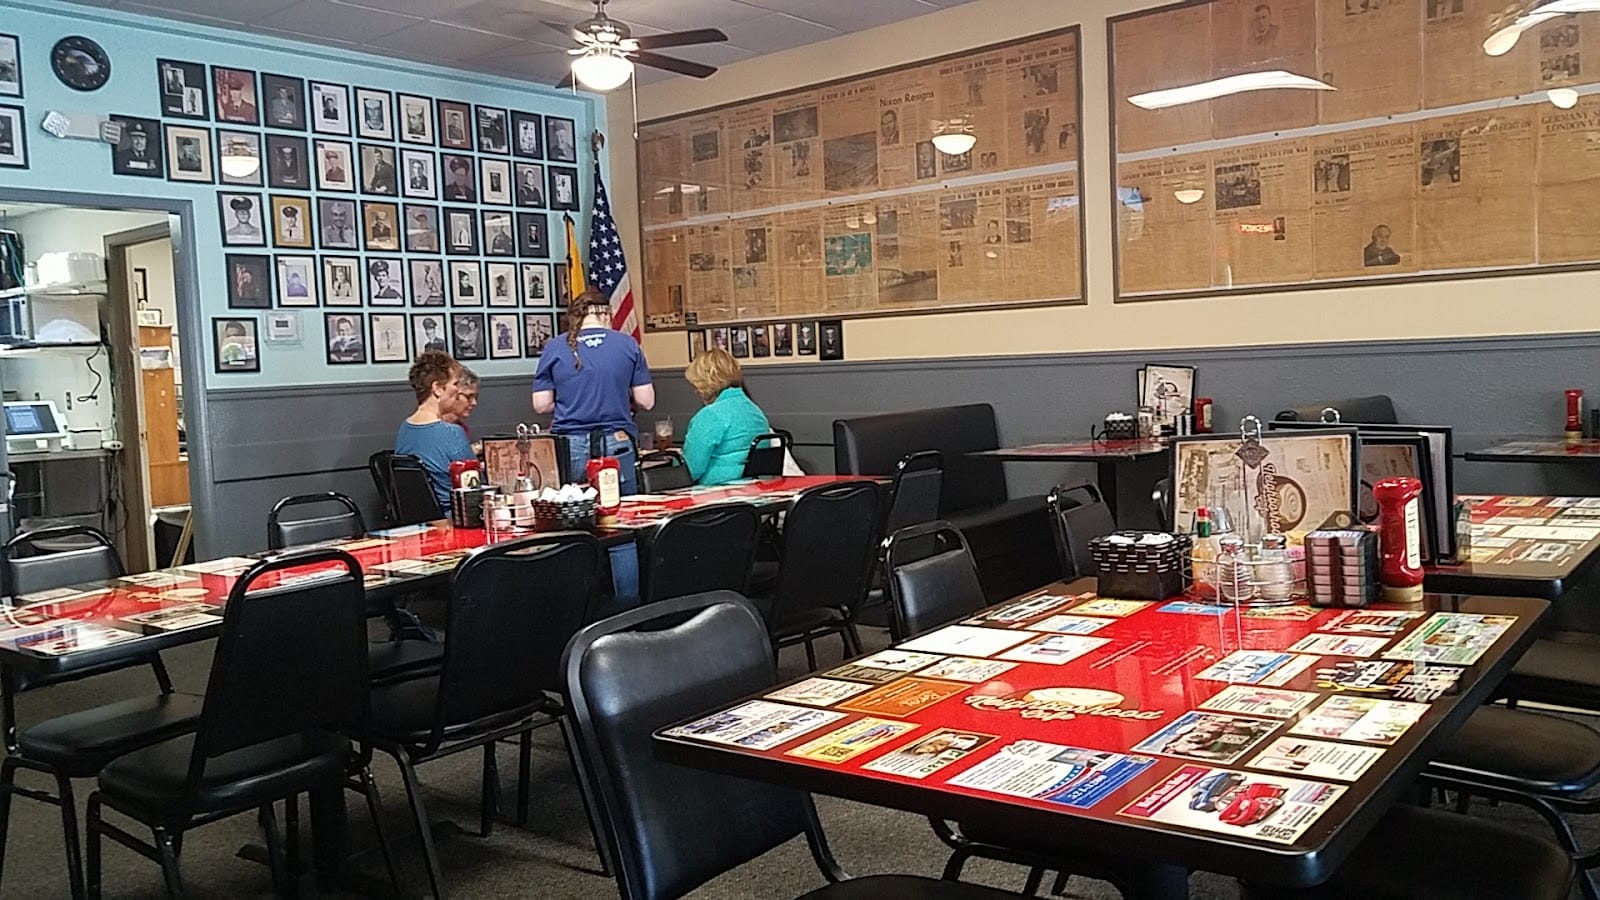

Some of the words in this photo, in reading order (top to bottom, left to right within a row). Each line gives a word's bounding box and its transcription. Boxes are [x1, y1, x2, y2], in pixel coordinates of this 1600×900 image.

[879, 97, 903, 107] Nixon
[904, 91, 935, 104] Resigns
[1541, 111, 1588, 124] GERMANY
[1546, 120, 1586, 132] LONDON
[1262, 462, 1282, 536] Neighborhoo
[963, 694, 1165, 721] Neighborhood
[1019, 708, 1076, 722] Cafe
